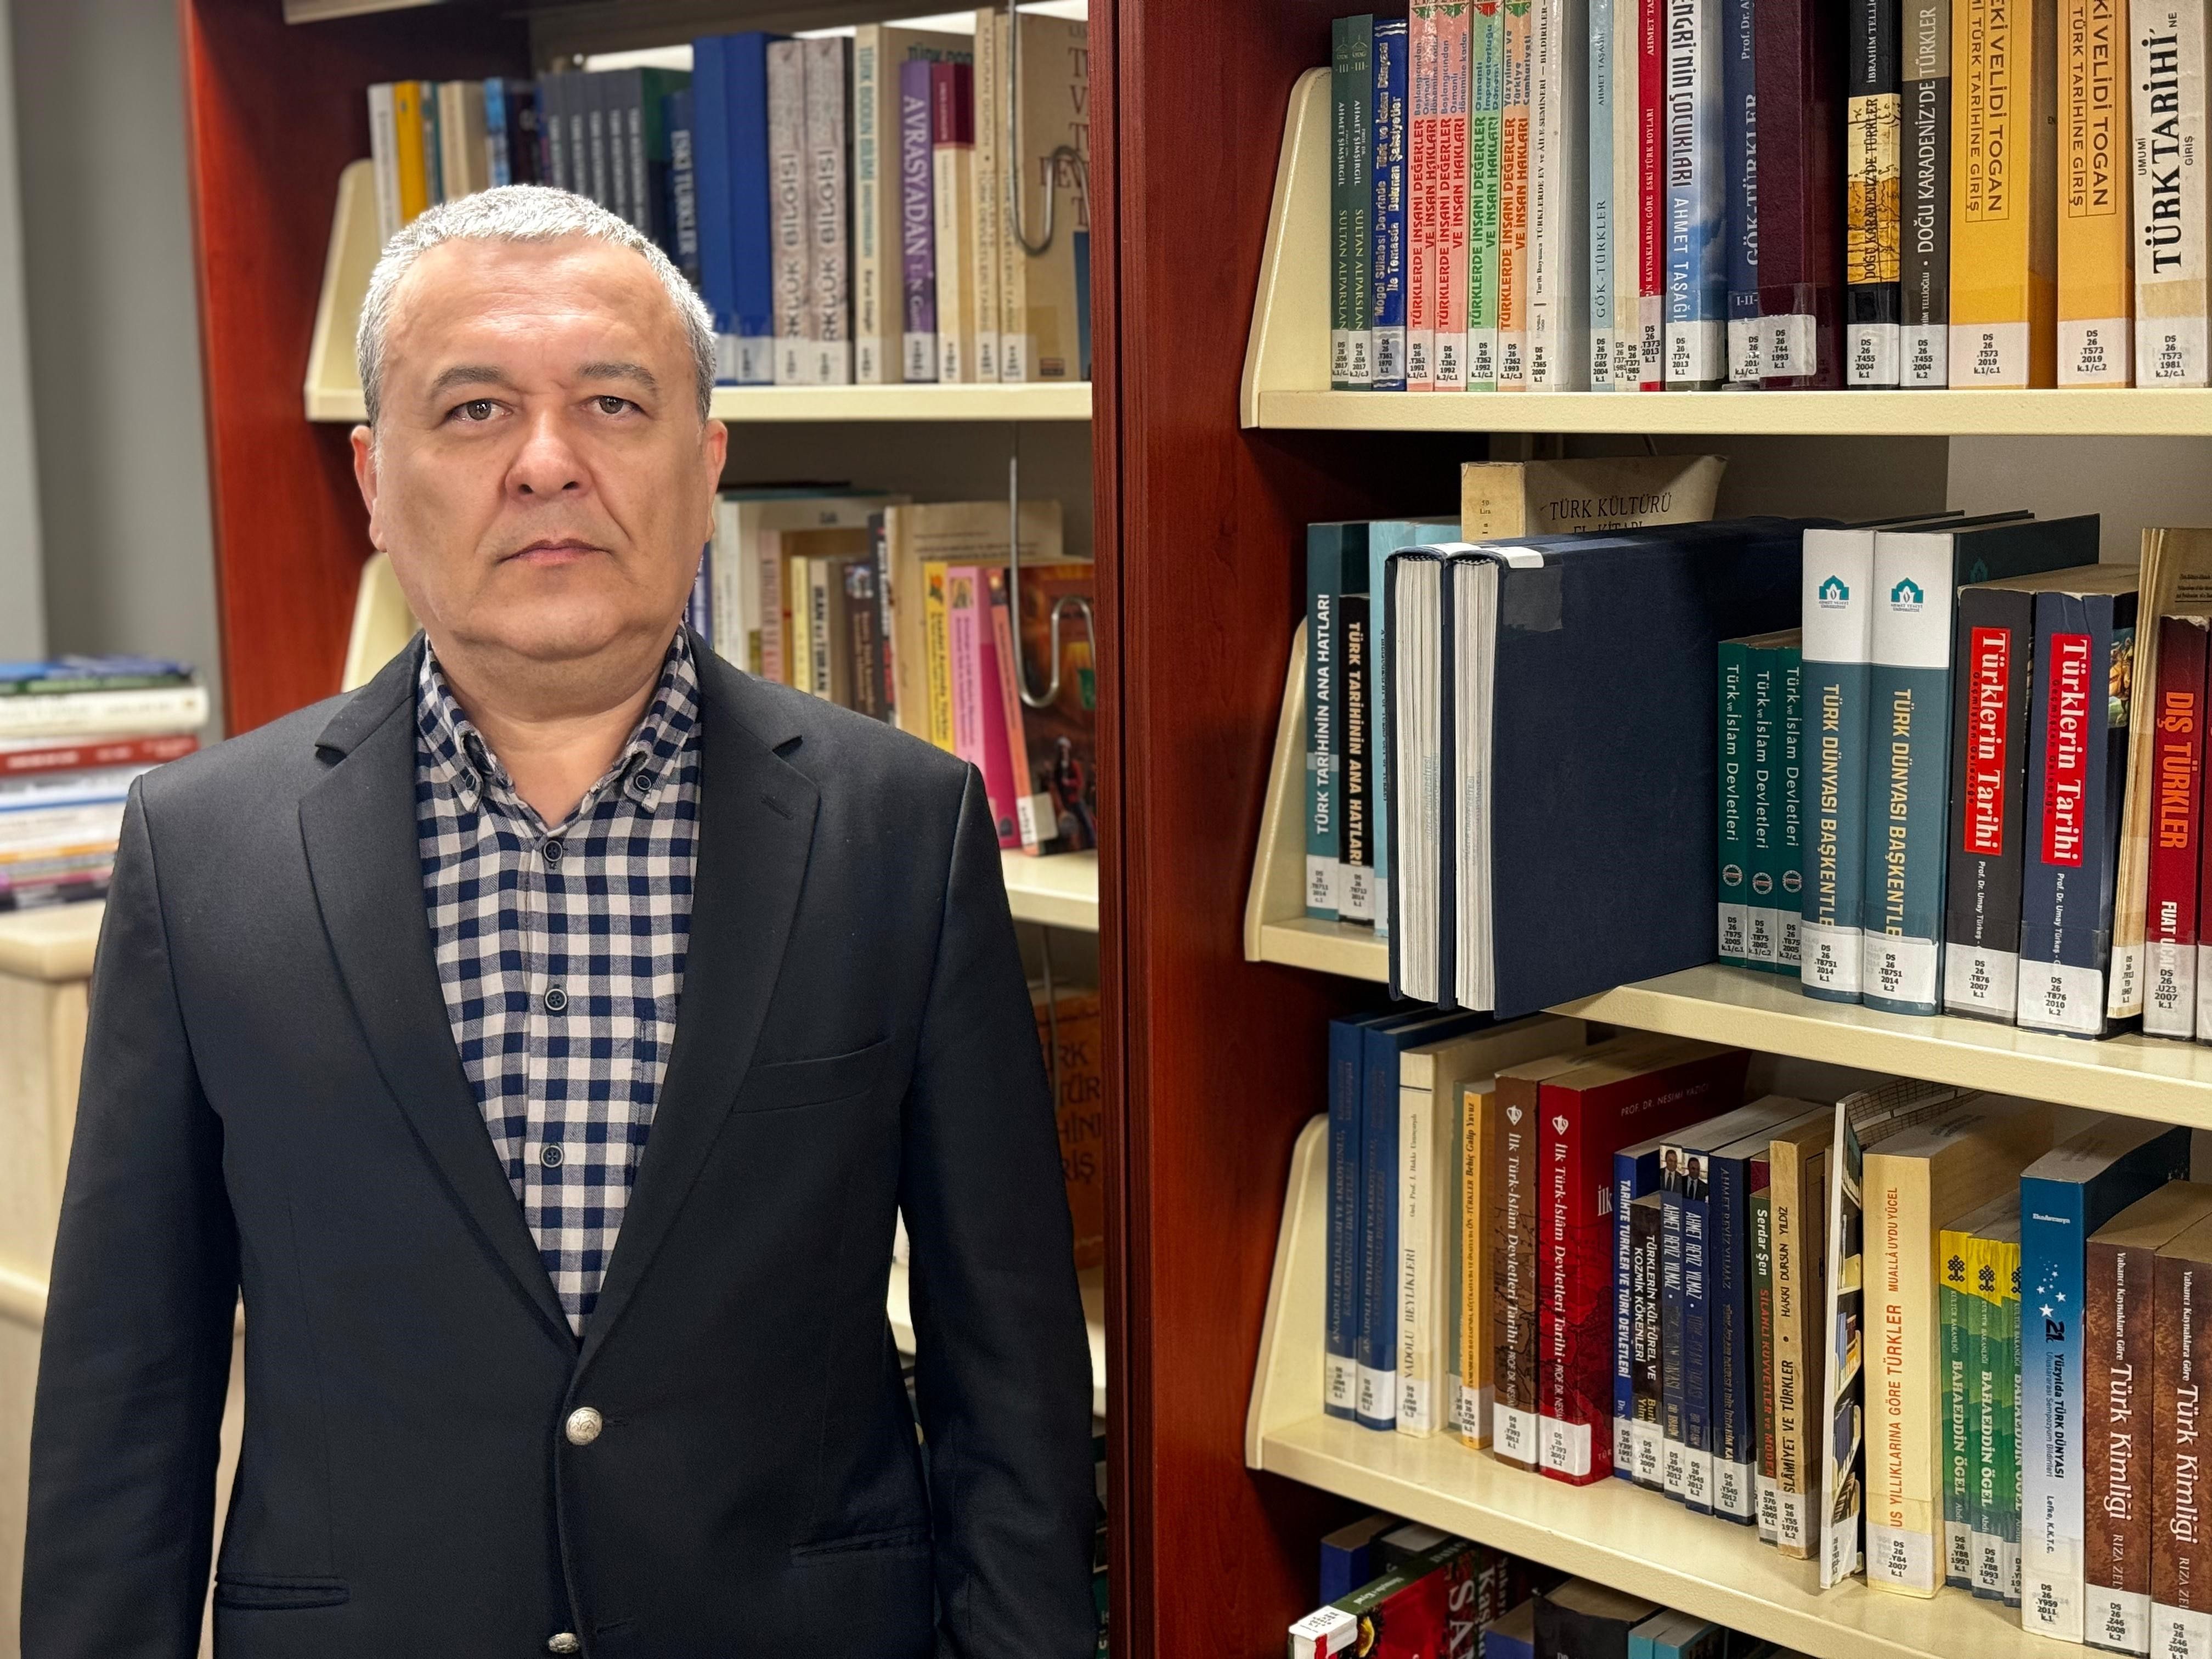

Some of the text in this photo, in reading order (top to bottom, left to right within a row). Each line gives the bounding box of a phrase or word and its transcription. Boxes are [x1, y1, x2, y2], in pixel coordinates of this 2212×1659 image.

[1915, 7, 1936, 77] TÜRKLER
[2168, 12, 2177, 28] NE
[1646, 108, 1654, 143] BOYLARI
[1967, 18, 1984, 211] TÜRK TARİHİNE GİRİŞ
[1988, 35, 2007, 211] VELİDİ TOGAN
[2069, 6, 2086, 206] TÜRK TARİHİNE GİRİŞ
[2093, 27, 2112, 206] VELİDİ TOGAN
[904, 95, 928, 256] AVRASYADAN
[1437, 118, 1452, 190] DEĞERLER
[1451, 118, 1464, 249] VE İNSAN HAKLARI
[1471, 116, 1486, 189] DEĞERLER
[1484, 116, 1499, 248] VE İNSAN HAKLARI
[1538, 166, 1544, 178] EV
[1645, 144, 1654, 169] TÜRK
[1645, 172, 1654, 190] ESKİ
[1645, 221, 1654, 281] KAYNAKLARINA
[1674, 198, 1689, 253] AHMET
[1914, 204, 1934, 253] DOĞU
[2145, 165, 2182, 274] TÜRK
[1355, 210, 1363, 330] SULTAN ALPARSLAN
[1437, 247, 1449, 328] TÜRKLERDE
[1470, 246, 1483, 328] TÜRKLERDE
[1594, 200, 1606, 318] GÖK-TÜRKLER
[1550, 492, 1672, 520] TÜRK KÜLTÜRÜ
[1726, 664, 1739, 699] Türk
[1726, 701, 1733, 712] ve
[1314, 594, 1330, 834] TÜRK TARİHİNİN ANA HATLARI
[1348, 622, 1364, 866] TÜRK TARİHİNİN ANA HATLARI
[1976, 632, 2006, 850] Türklerin Tarihi
[1821, 684, 1843, 815] TÜRK DÜNYASI
[1889, 688, 1915, 821] TÜRK DÜNYASI
[2054, 639, 2088, 860] Türklerin Tarihi
[2157, 691, 2198, 849] DIŞ TÜRKLER
[1726, 763, 1740, 840] Devletleri
[2053, 907, 2063, 926] Umay
[2161, 901, 2177, 934] FUAT
[2045, 1000, 2065, 1008] 2010
[2155, 993, 2178, 1001] 2007
[2158, 1001, 2173, 1009] k.1
[1685, 1211, 1702, 1239] AHMET
[1884, 1187, 1898, 1219] YÜCEL
[1756, 1209, 1769, 1276] Serdar Şen
[1779, 1206, 1791, 1318] HAKKI DURSUN YILDIZ
[1888, 1222, 1899, 1249] UYDU
[1554, 1245, 1566, 1314] Devletleri
[1619, 1273, 1630, 1286] VE
[1634, 1247, 1645, 1294] KOZMİK
[1686, 1270, 1702, 1300] YILMAZ
[1554, 1317, 1566, 1358] Tarihi
[1647, 1302, 1658, 1361] KÜLTÜREL
[2116, 1339, 2126, 1361] Göre
[1647, 1365, 1656, 1381] VE
[1780, 1359, 1795, 1436] VE TÜRKLER
[1882, 1304, 1903, 1505] YILLIKLARINA GÖRE TÜRKLER
[2055, 1400, 2064, 1429] TÜRK
[2103, 1363, 2133, 1521] Türk Kimliği
[2055, 1431, 2066, 1479] DÜNYASI
[2170, 1384, 2200, 1544] Türk Kimliği
[2113, 1534, 2124, 1563] RIZA
[2179, 1557, 2190, 1585] RIZA
